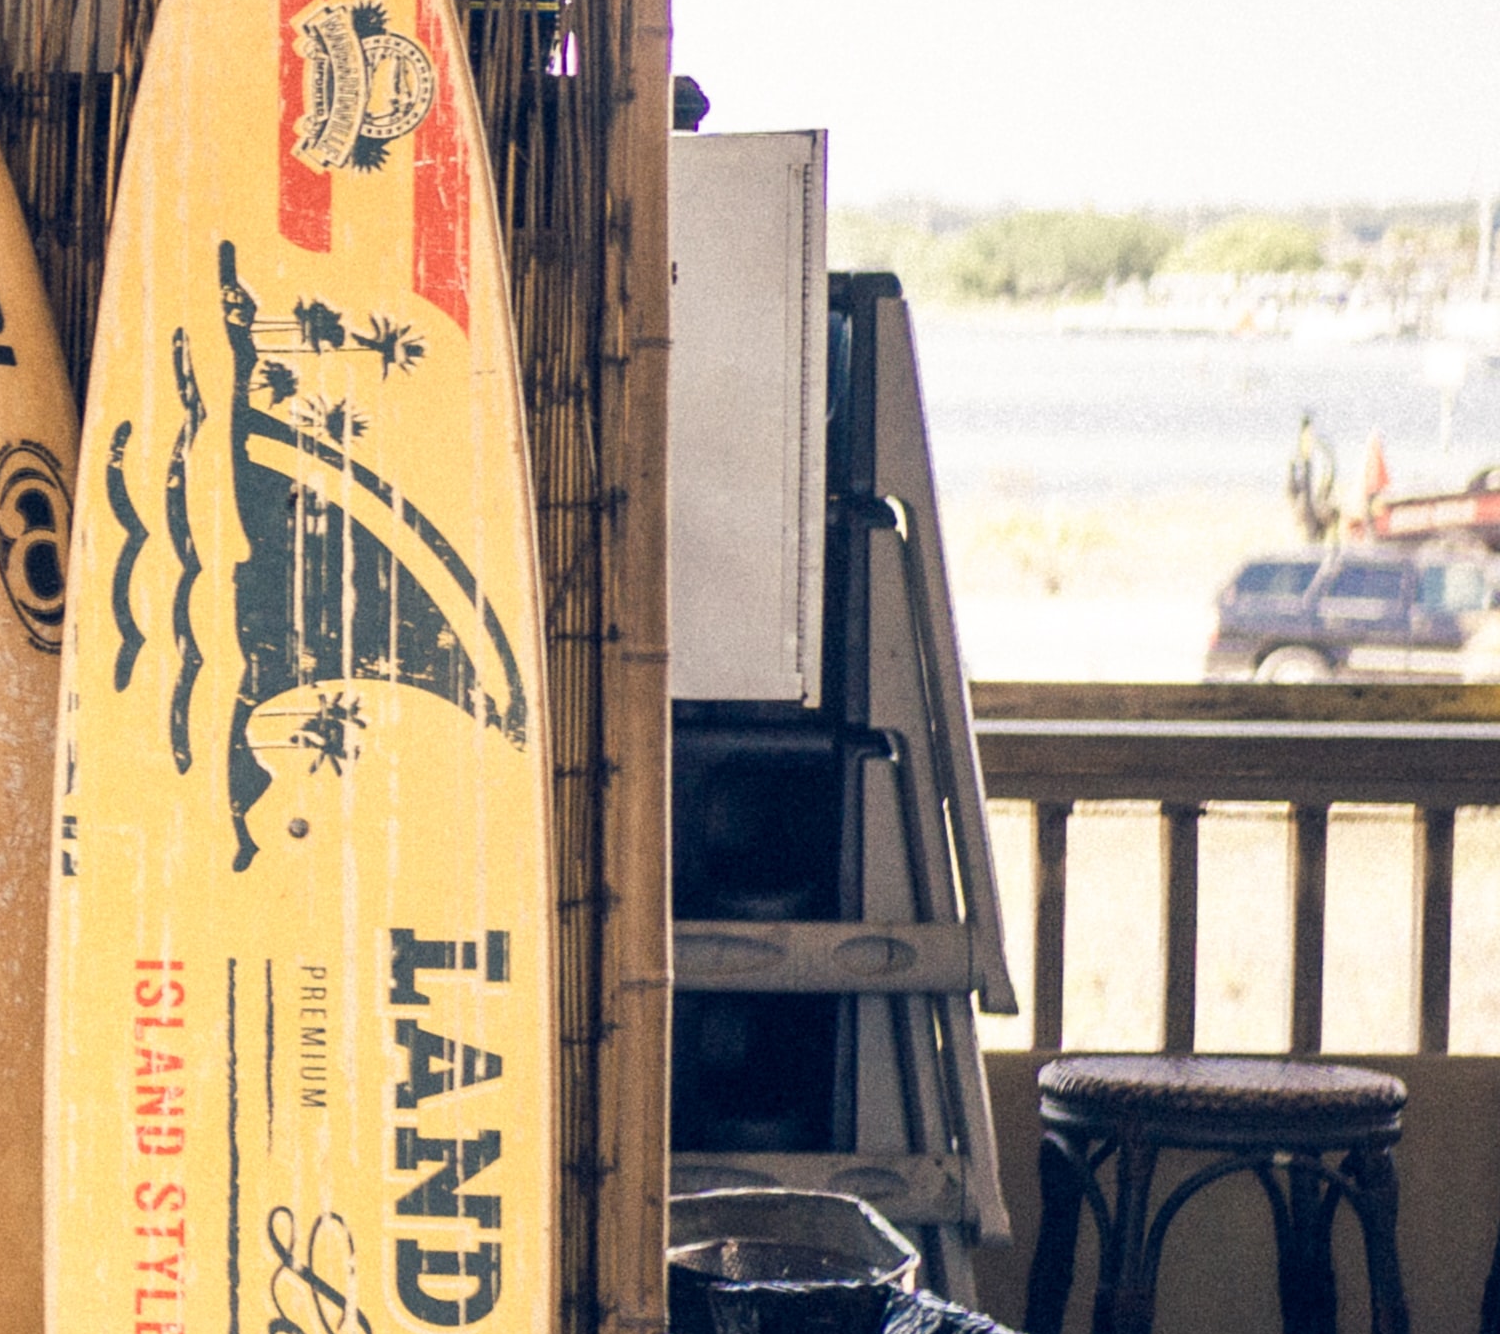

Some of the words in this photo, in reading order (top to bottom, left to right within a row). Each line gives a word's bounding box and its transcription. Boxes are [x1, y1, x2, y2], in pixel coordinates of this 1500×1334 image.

[315, 58, 326, 116] IMPORTED
[132, 958, 186, 1160] ISLAND
[299, 964, 328, 1110] PREMIUM
